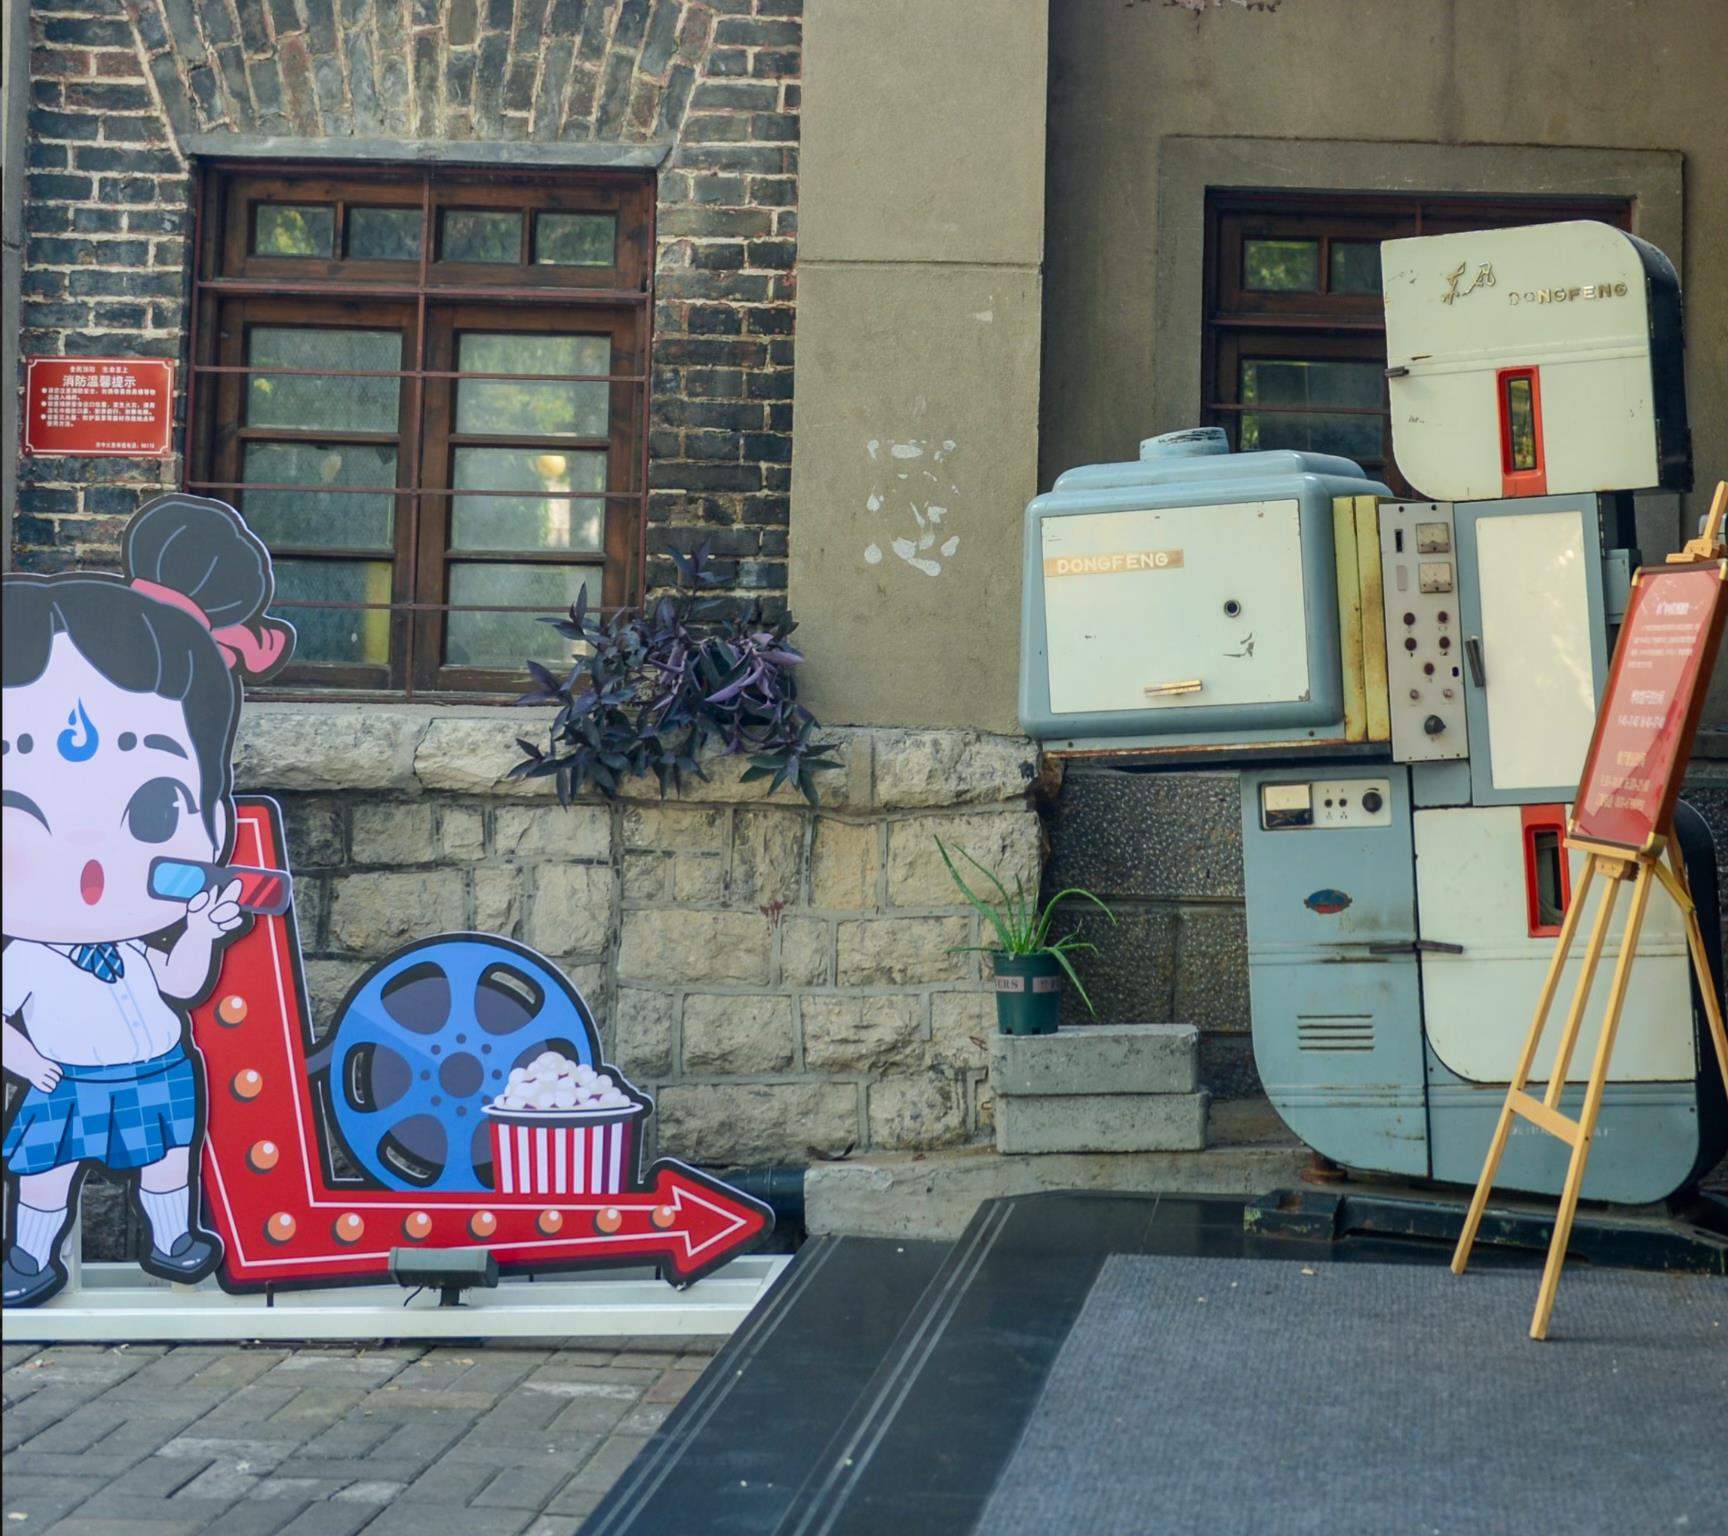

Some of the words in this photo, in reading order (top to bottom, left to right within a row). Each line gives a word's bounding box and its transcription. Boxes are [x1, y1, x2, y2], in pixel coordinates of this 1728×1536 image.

[63, 375, 137, 388] 消防温馨提示
[1057, 551, 1170, 575] DONGFENG
